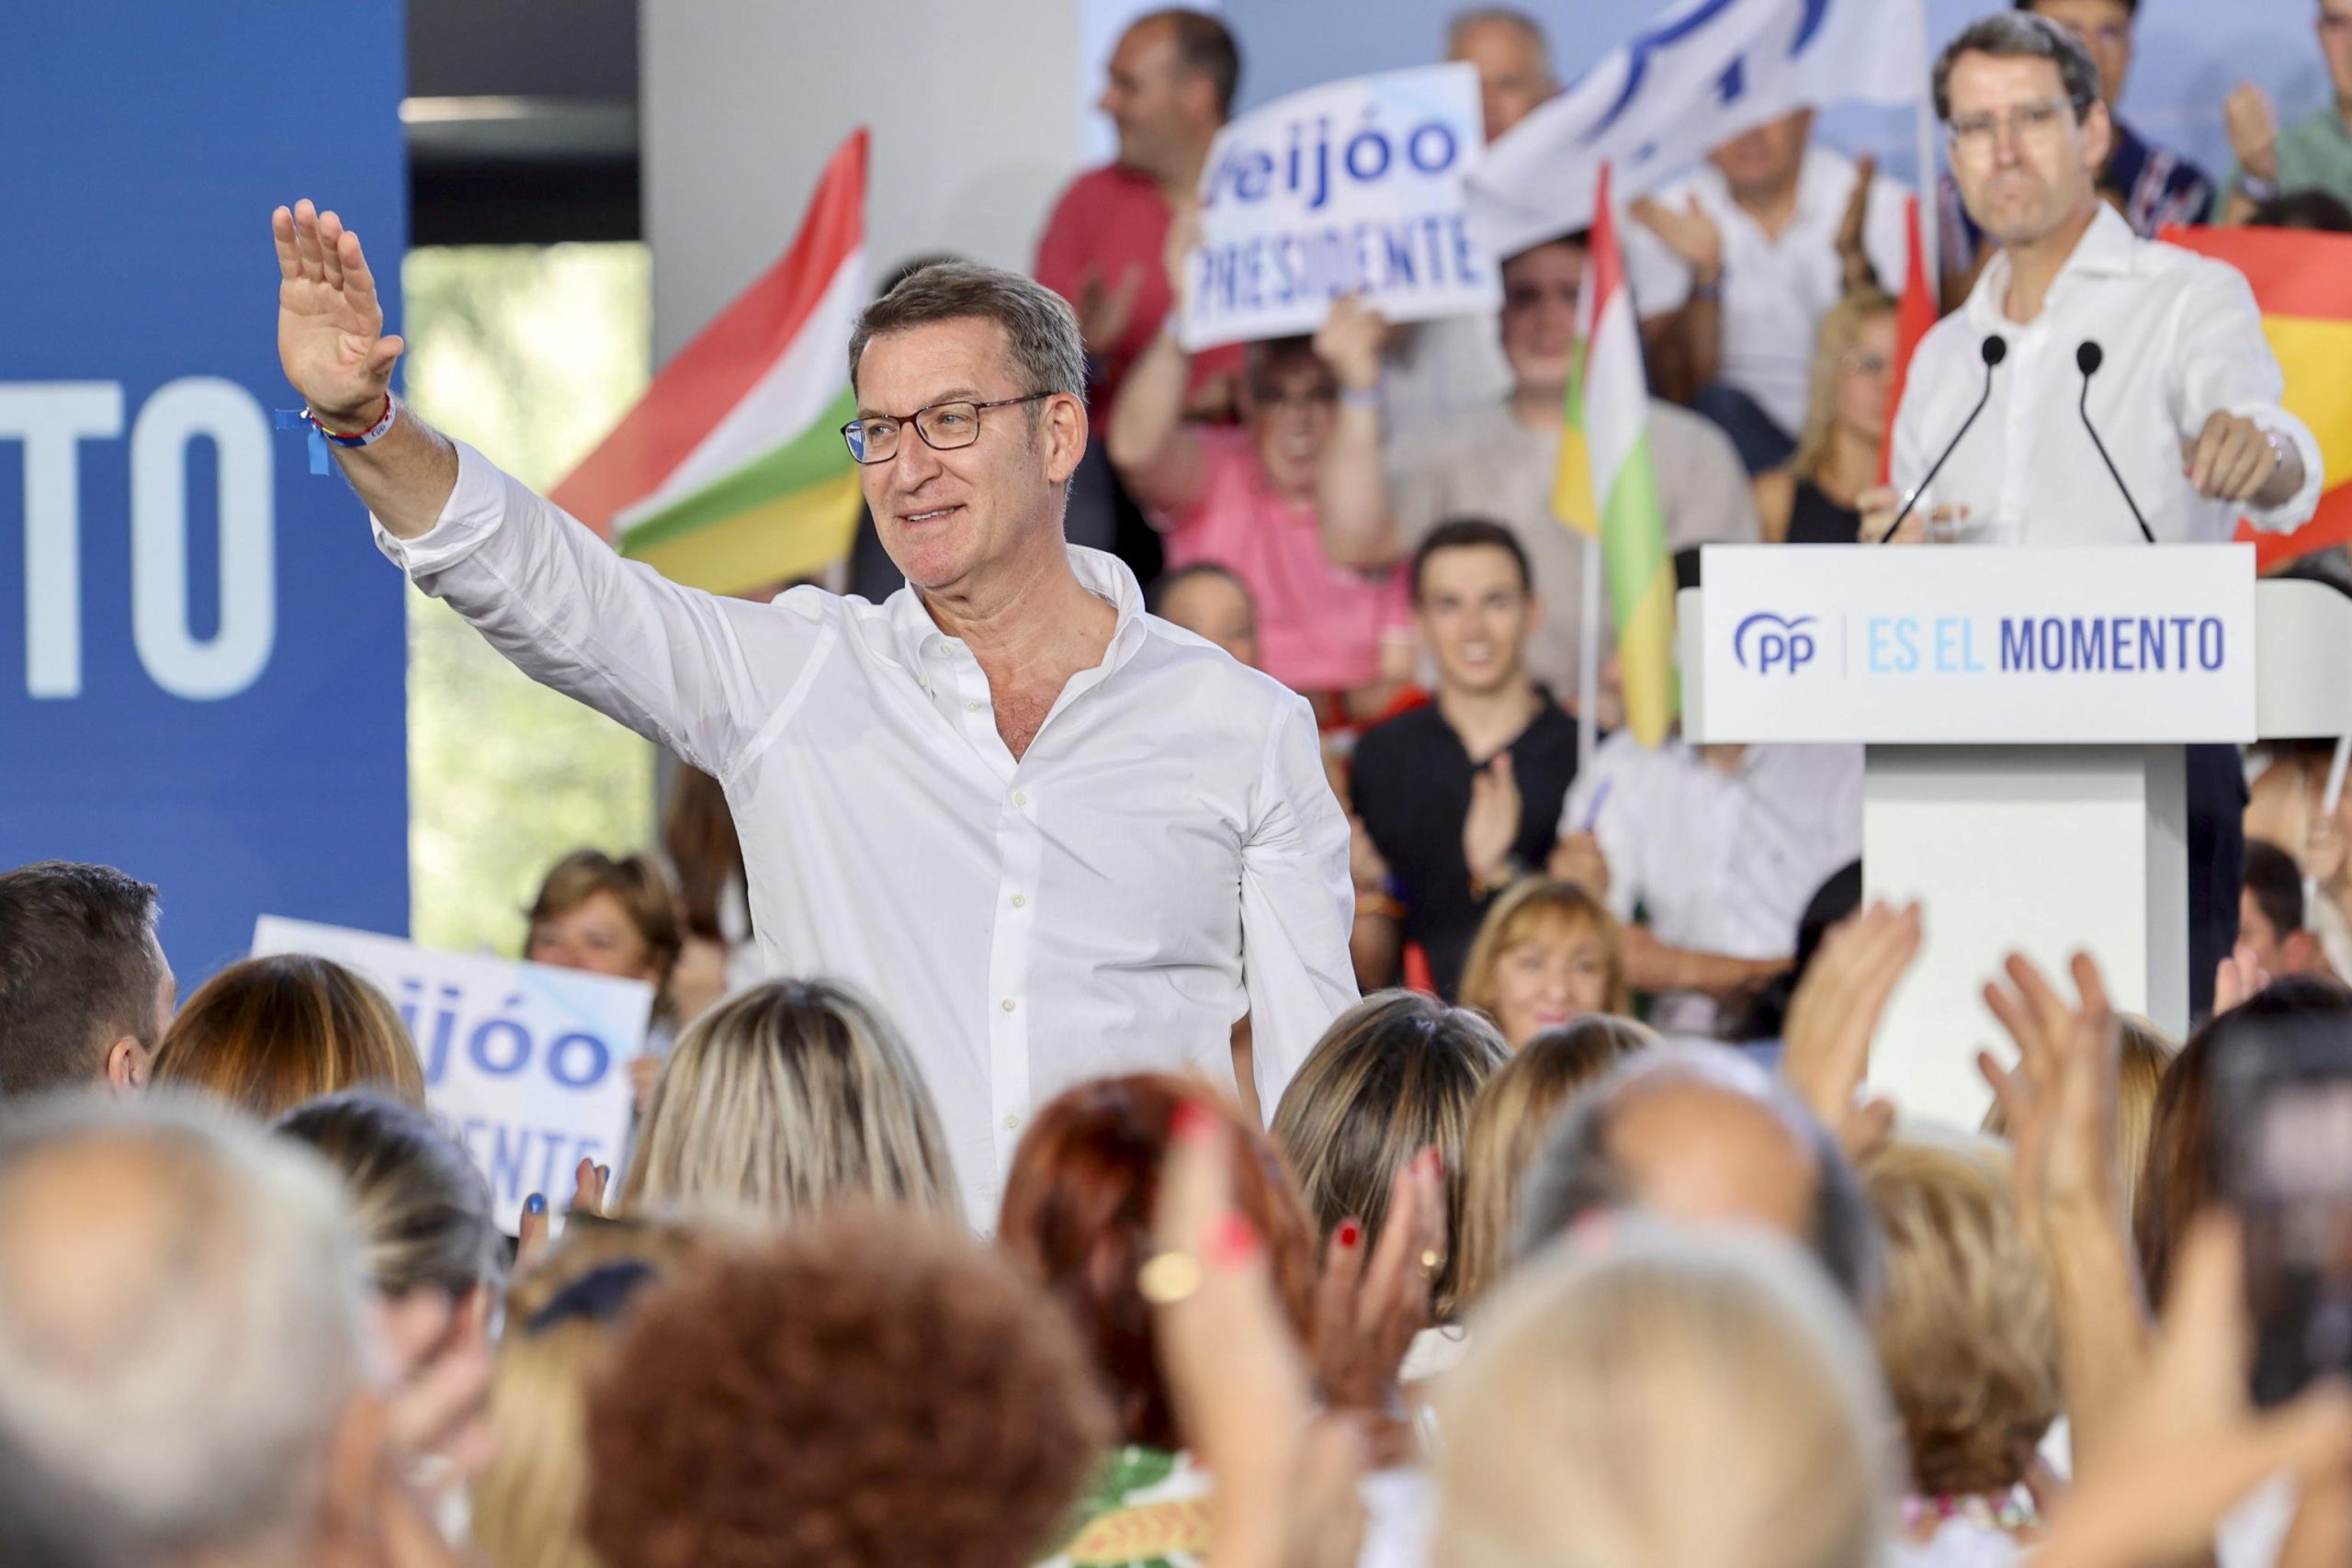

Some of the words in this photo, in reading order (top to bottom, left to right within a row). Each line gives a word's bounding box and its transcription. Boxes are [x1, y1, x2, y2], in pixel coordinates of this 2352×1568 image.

[1868, 616, 1920, 673] ES
[1935, 616, 1985, 673] EL
[2000, 615, 2225, 674] MOMENTO
